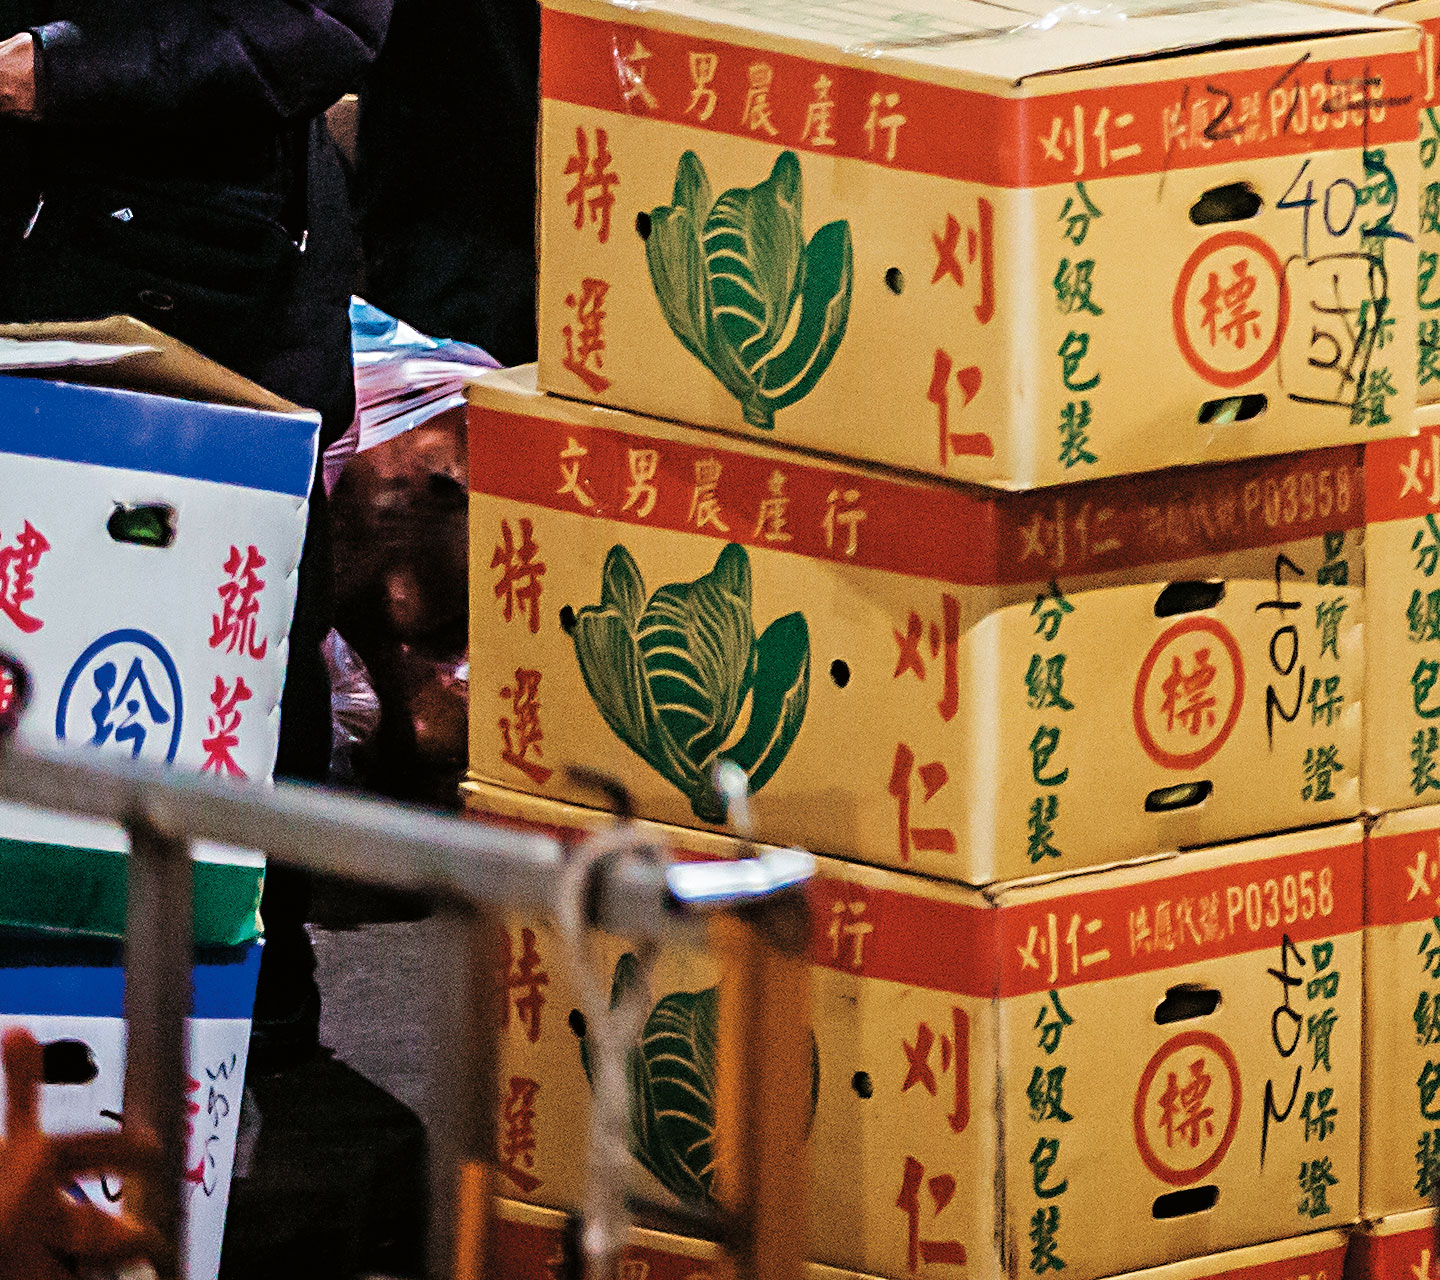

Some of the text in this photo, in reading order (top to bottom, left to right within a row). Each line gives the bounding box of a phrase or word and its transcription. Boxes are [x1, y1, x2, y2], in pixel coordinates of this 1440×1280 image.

[562, 127, 618, 393] 特選
[1041, 105, 1141, 164] 刈仁
[928, 198, 994, 465] 刈仁
[1052, 184, 1102, 466] 分級包裝
[1200, 261, 1262, 351] 標
[556, 438, 867, 557] 文男農產行
[491, 518, 551, 785] 特選
[889, 594, 960, 861] 刈仁
[1024, 582, 1074, 862] 分級包裝
[1162, 656, 1216, 735] 標
[1302, 532, 1349, 802] 品質保證
[828, 901, 873, 967] 行
[1018, 913, 1110, 982] 刈仁
[897, 1006, 970, 1273] 刈仁
[1028, 992, 1072, 1273] 分級包裝
[1160, 1070, 1214, 1149] 標
[1299, 941, 1339, 1217] 品質保證
